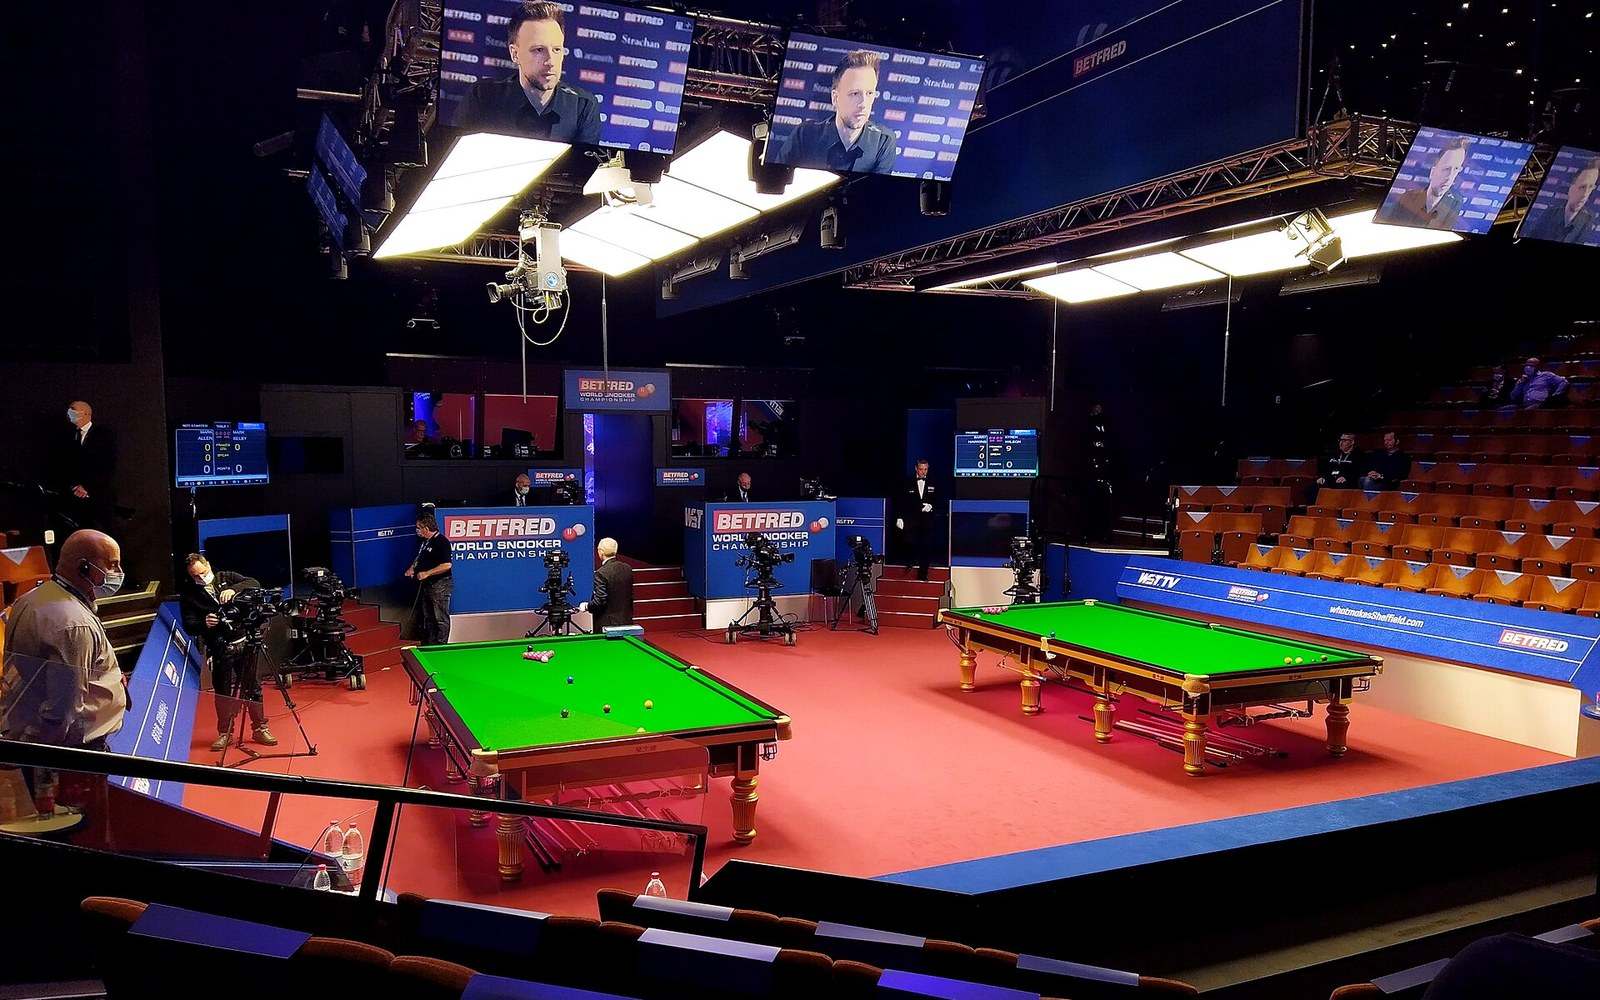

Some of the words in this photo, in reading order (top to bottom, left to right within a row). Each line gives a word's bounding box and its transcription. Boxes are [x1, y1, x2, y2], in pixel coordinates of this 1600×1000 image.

[580, 6, 619, 19] BETFRED
[624, 12, 664, 26] BETFRED
[577, 27, 617, 41] BETFRED
[622, 34, 660, 49] Strachan
[1075, 40, 1127, 75] BETFRED
[923, 77, 955, 89] Strachan
[204, 443, 211, 451] 0
[234, 443, 241, 451] 0
[204, 453, 211, 462] 0
[203, 464, 211, 474] 0
[235, 464, 242, 473] 0
[716, 511, 805, 530] BETFRED
[449, 517, 556, 538] BETFRED
[713, 534, 745, 542] WORL
[761, 532, 809, 541] NOOKER
[497, 540, 562, 550] SNOOKER
[451, 550, 547, 560] HAMPIONSH
[1329, 605, 1424, 628] whatmakesSheffield.com
[1501, 632, 1569, 653] BETFRED
